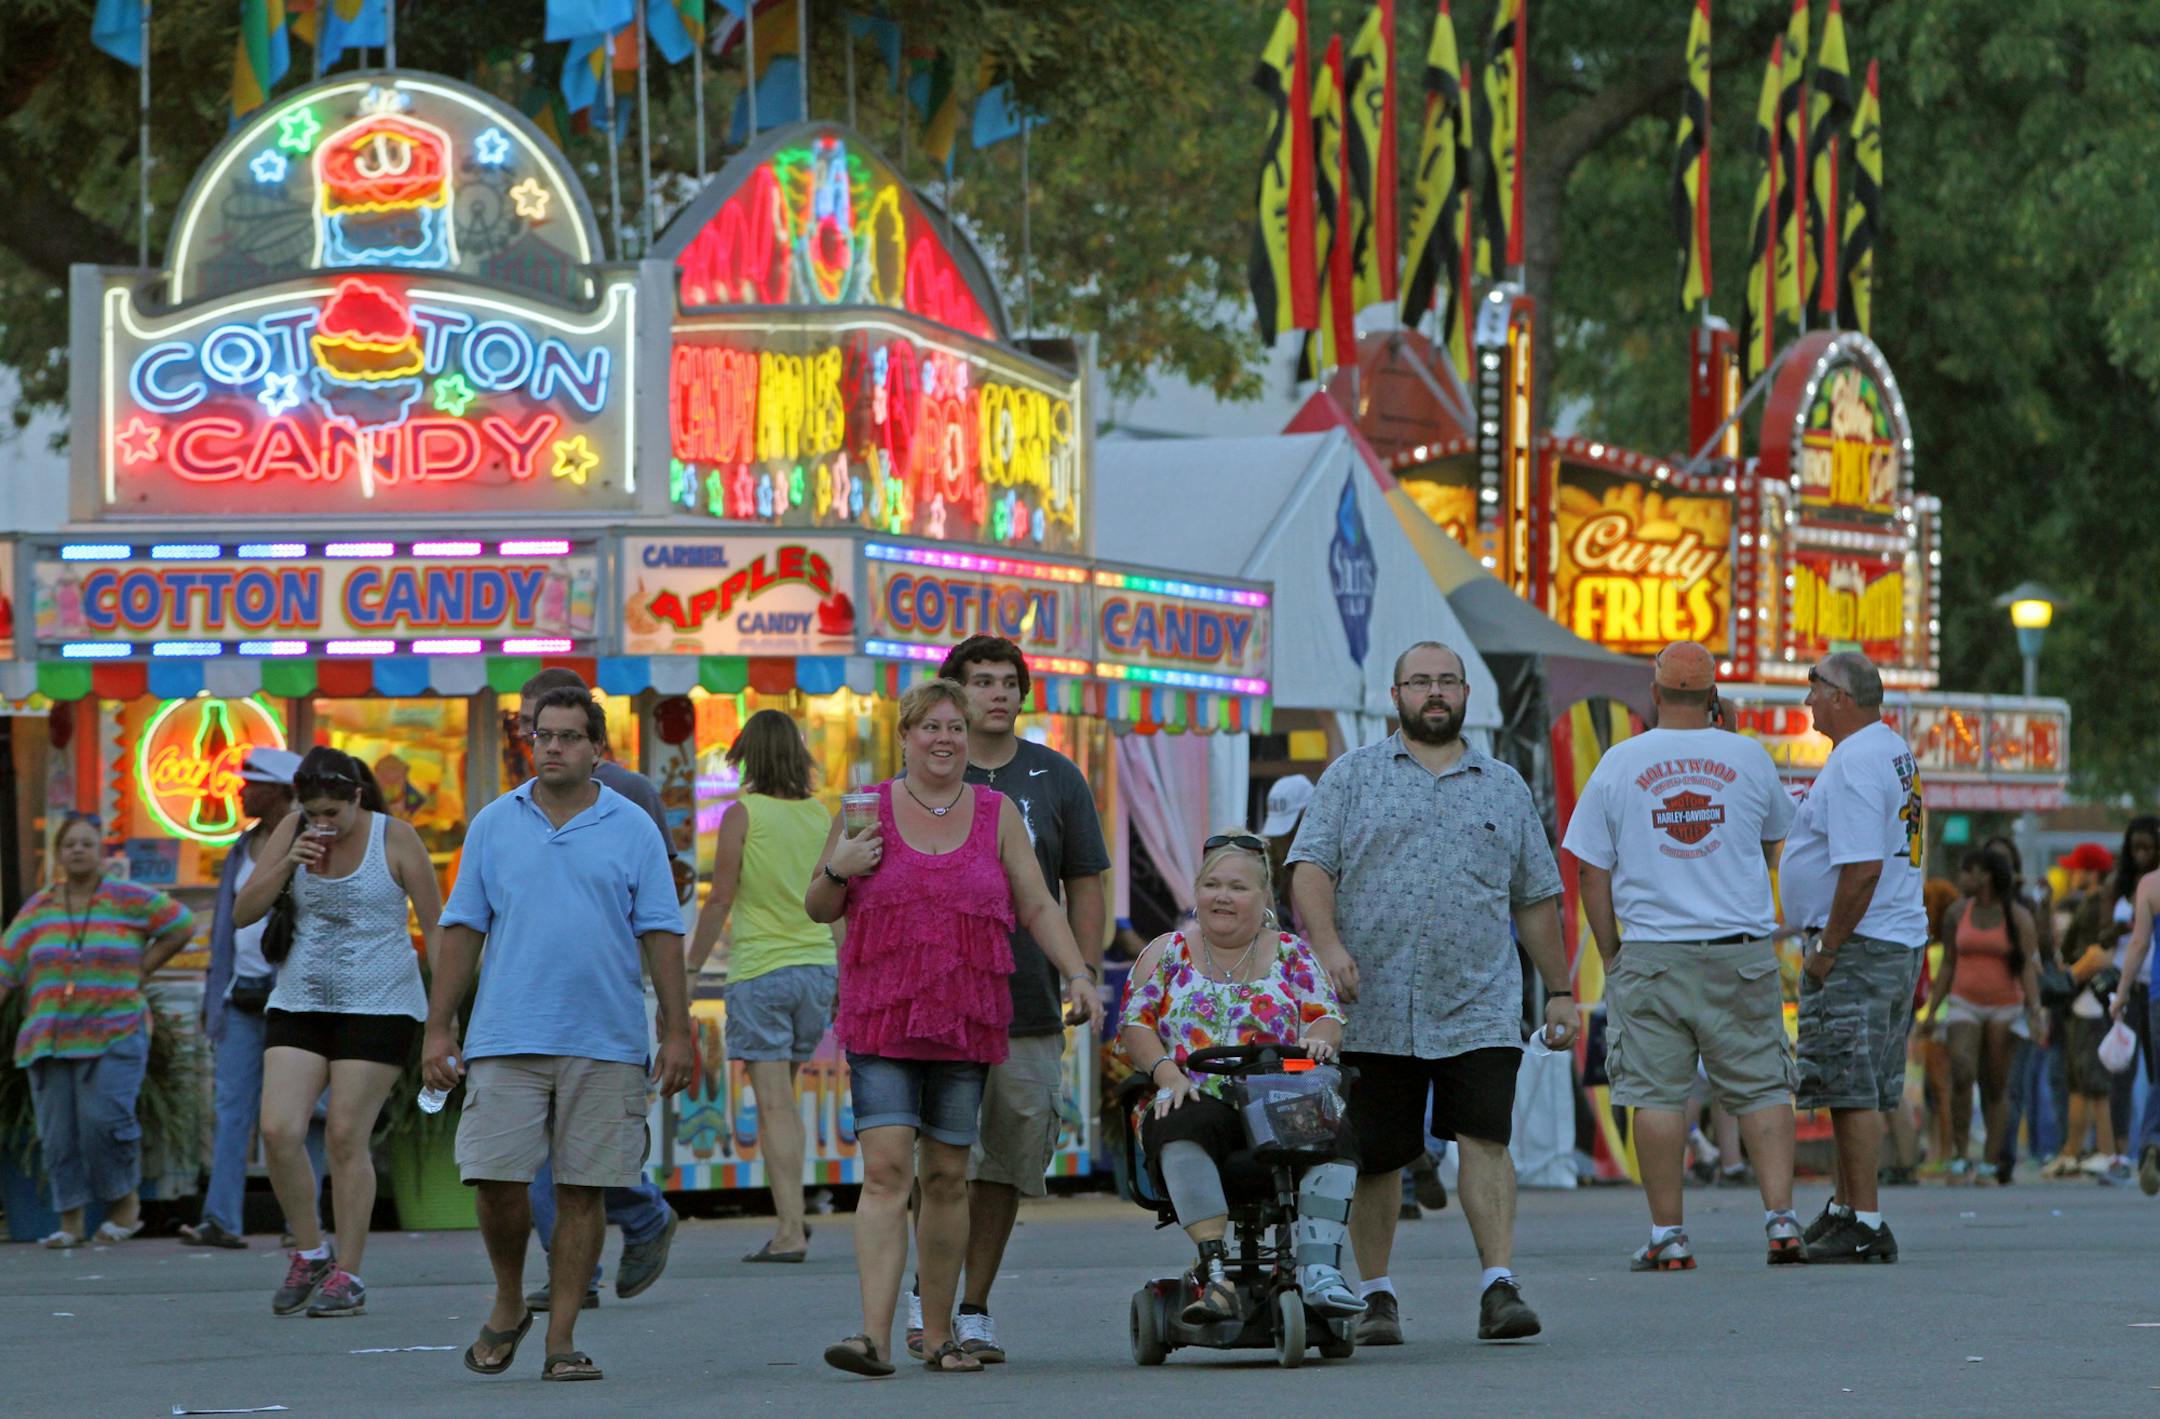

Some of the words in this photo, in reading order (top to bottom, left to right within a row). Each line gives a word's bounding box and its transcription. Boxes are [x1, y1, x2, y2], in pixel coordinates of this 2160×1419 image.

[169, 415, 560, 482] CANDY
[1573, 514, 1719, 592] Curly
[85, 567, 323, 631] COTTON
[344, 565, 549, 630] CANDY
[647, 545, 833, 631] APPLES
[884, 570, 1059, 646] COTTON
[1100, 596, 1253, 664] CANDY
[1573, 574, 1716, 642] FRIES
[736, 610, 814, 636] CANDY
[1635, 757, 1738, 792] HOLLYWOOD
[1656, 806, 1722, 824] HARLEY-DAVIDSON
